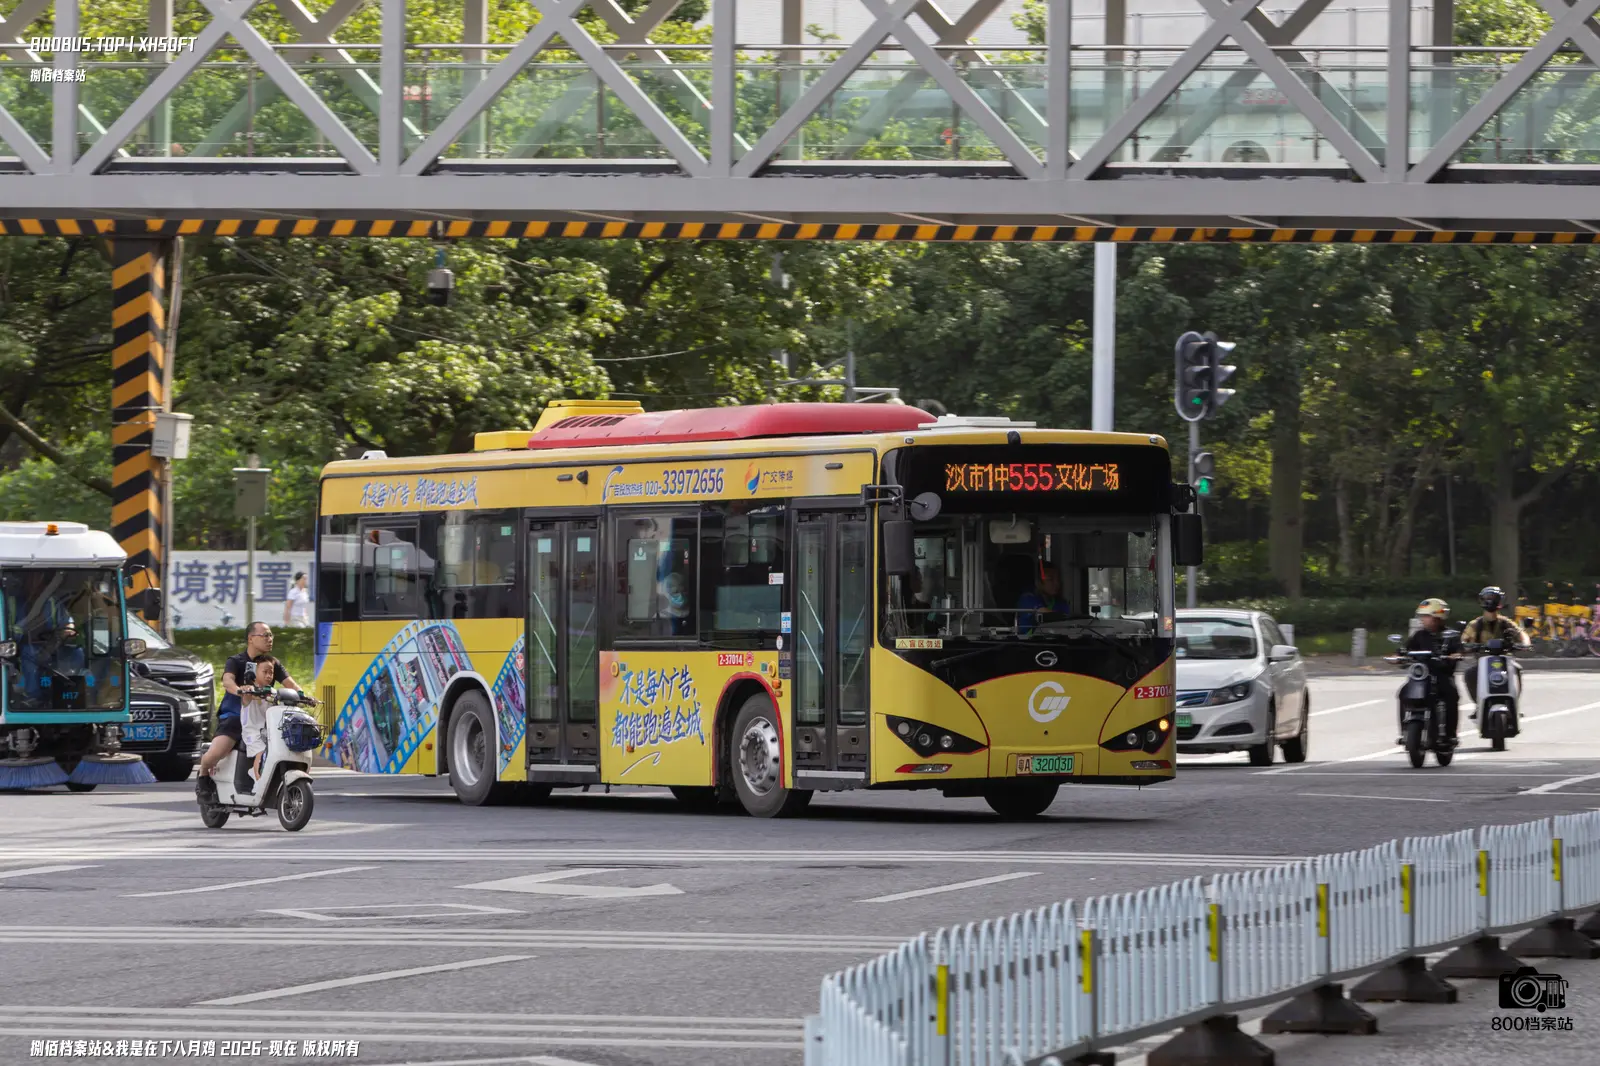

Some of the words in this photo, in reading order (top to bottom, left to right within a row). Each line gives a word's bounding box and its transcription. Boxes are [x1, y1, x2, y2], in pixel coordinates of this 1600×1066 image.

[645, 468, 724, 496] 020-33972656
[1009, 463, 1053, 491] 555
[1056, 463, 1119, 491] 文化广场
[171, 559, 315, 603] 境新置
[719, 654, 743, 665] 2-37014
[611, 701, 705, 757] 都能跑遍全城
[1035, 757, 1073, 772] 32003D
